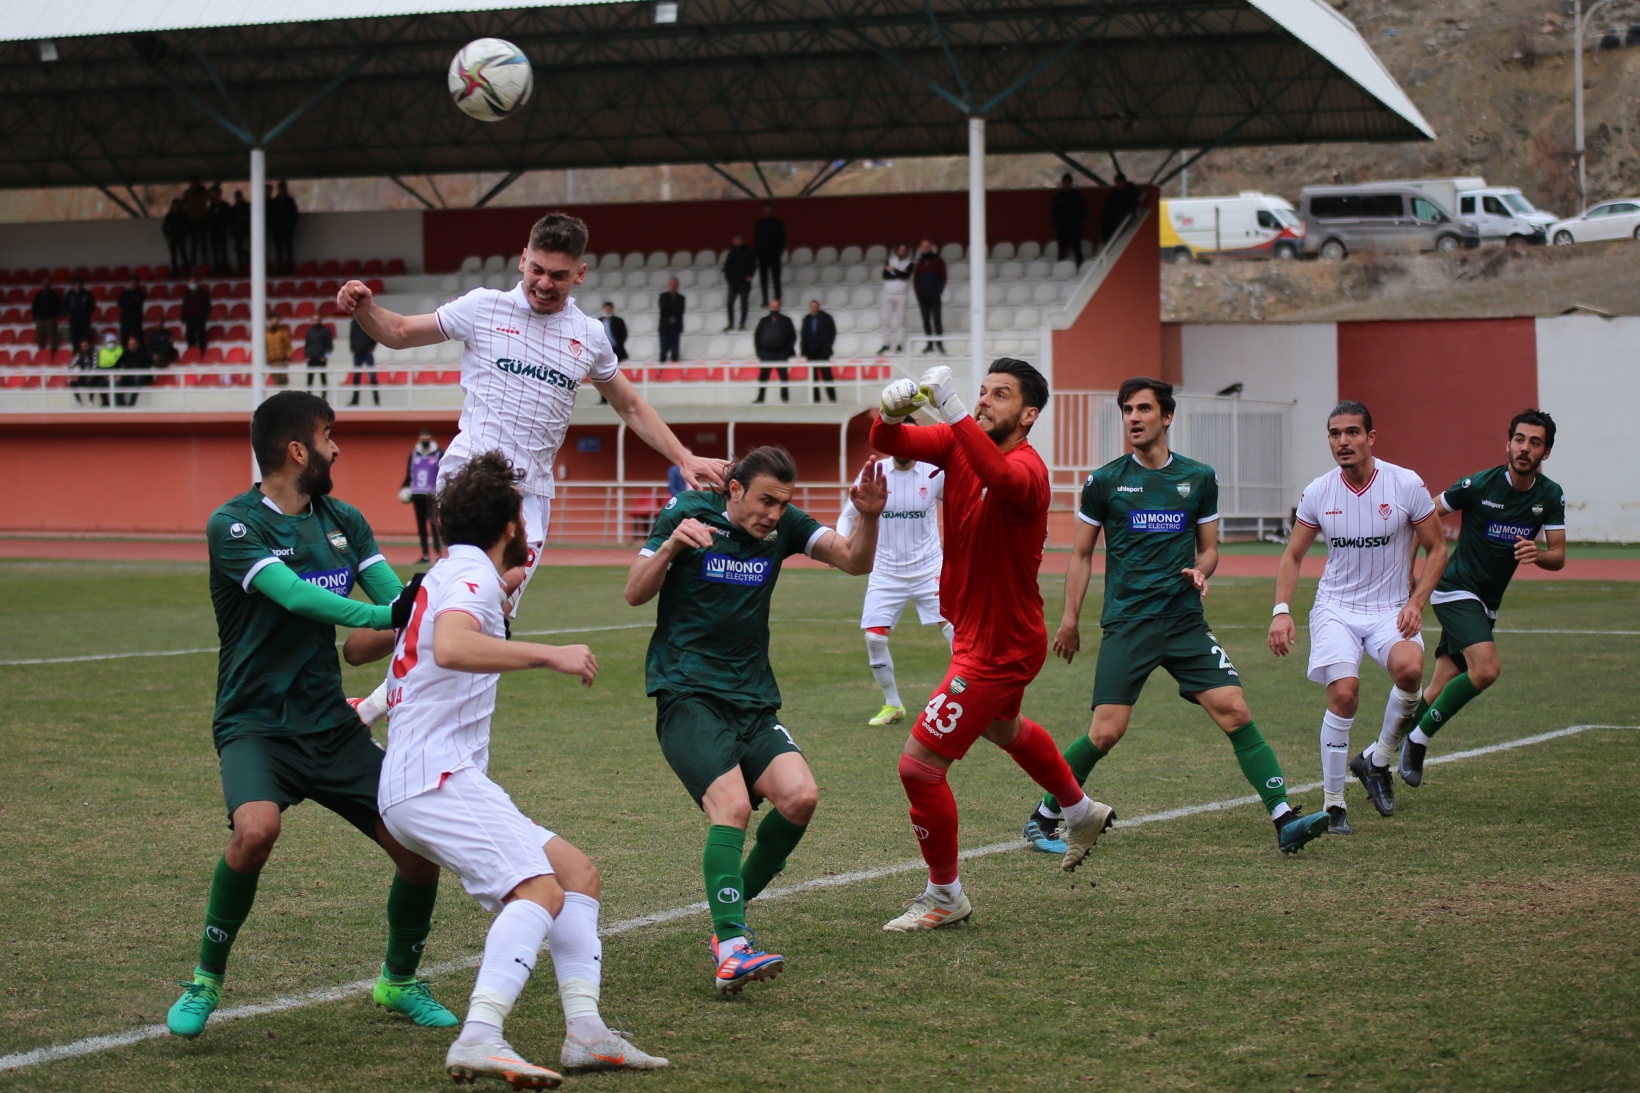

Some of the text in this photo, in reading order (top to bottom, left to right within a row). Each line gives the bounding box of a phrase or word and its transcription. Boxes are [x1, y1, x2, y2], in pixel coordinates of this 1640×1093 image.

[416, 469, 428, 487] 9
[1481, 500, 1504, 510] uhlsport
[725, 572, 763, 582] ELECTRIC
[924, 692, 963, 734] 43
[921, 720, 943, 739] uhlsport
